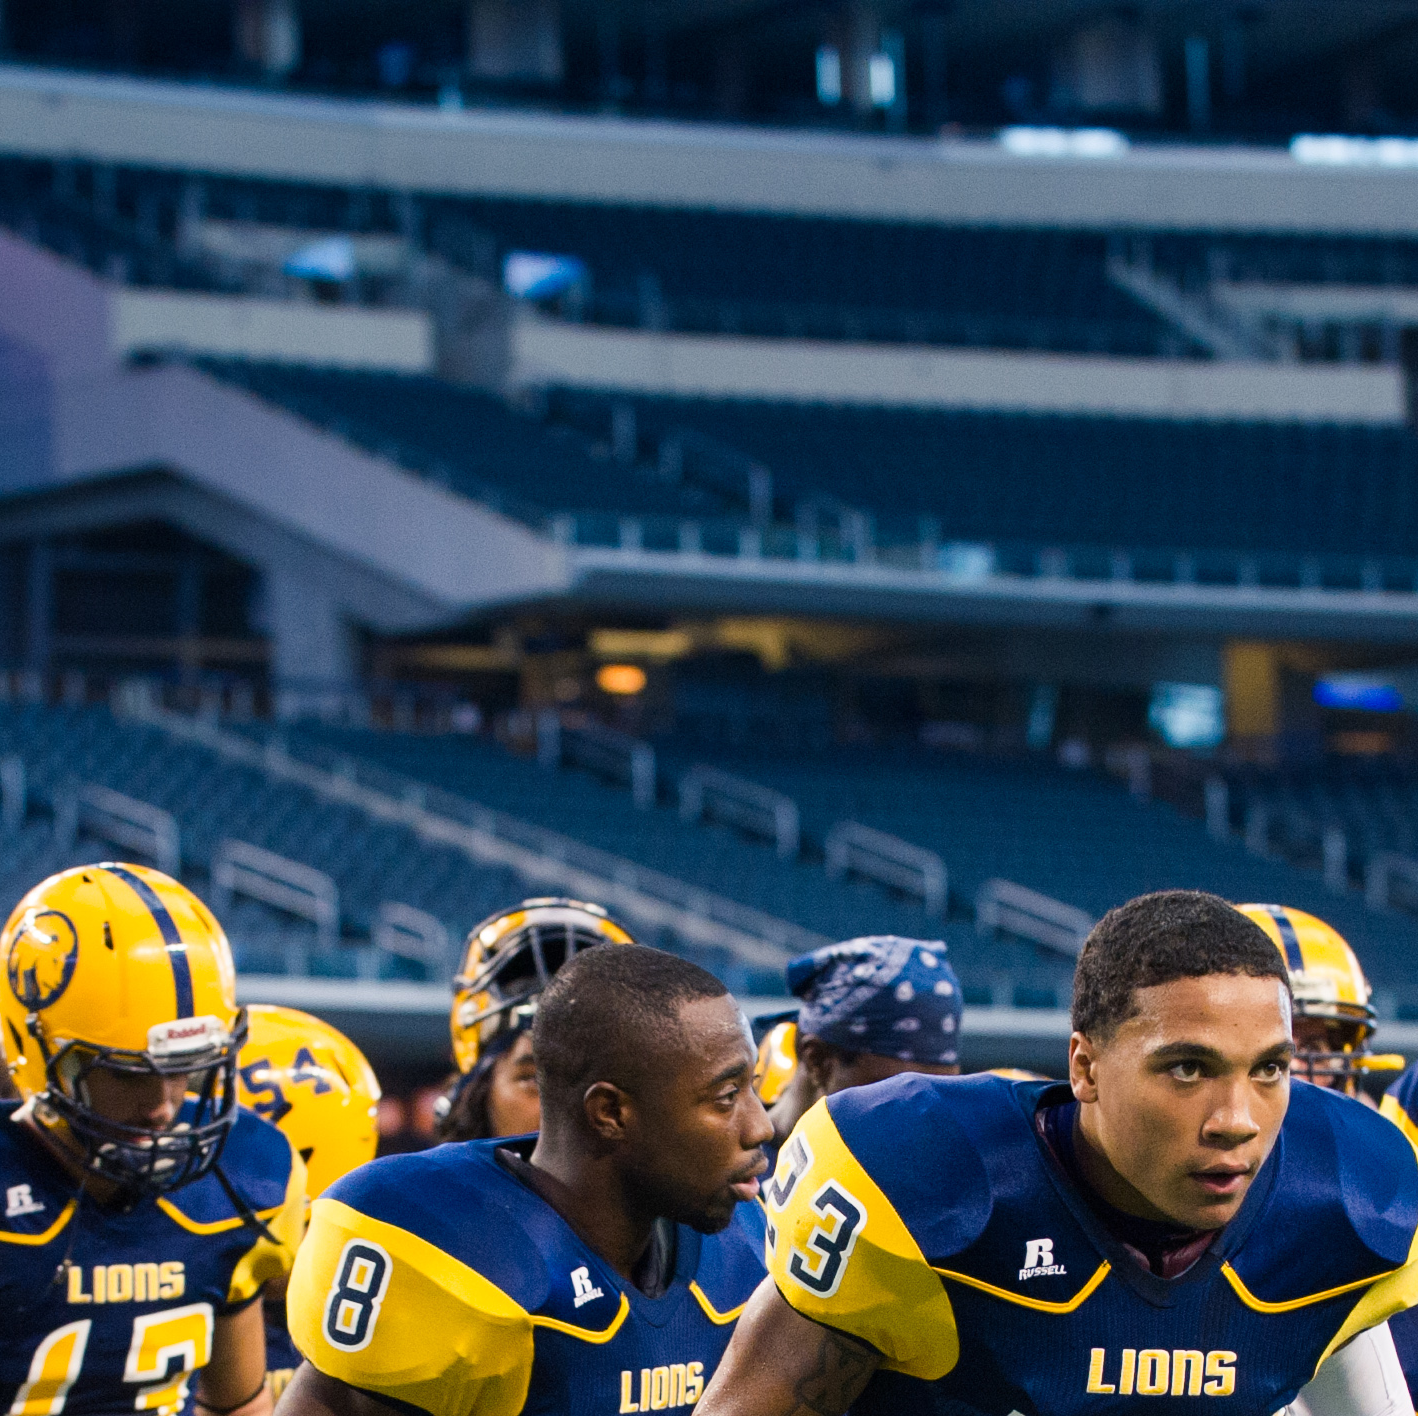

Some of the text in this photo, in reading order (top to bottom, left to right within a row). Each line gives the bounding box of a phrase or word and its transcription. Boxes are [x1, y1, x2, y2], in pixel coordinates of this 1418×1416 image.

[1018, 1263, 1067, 1281] RUSSELL
[1024, 1238, 1054, 1269] R
[67, 1261, 185, 1304] LIONS
[322, 1237, 393, 1352] 8
[619, 1361, 705, 1415] LIONS
[1087, 1347, 1238, 1398] LIONS
